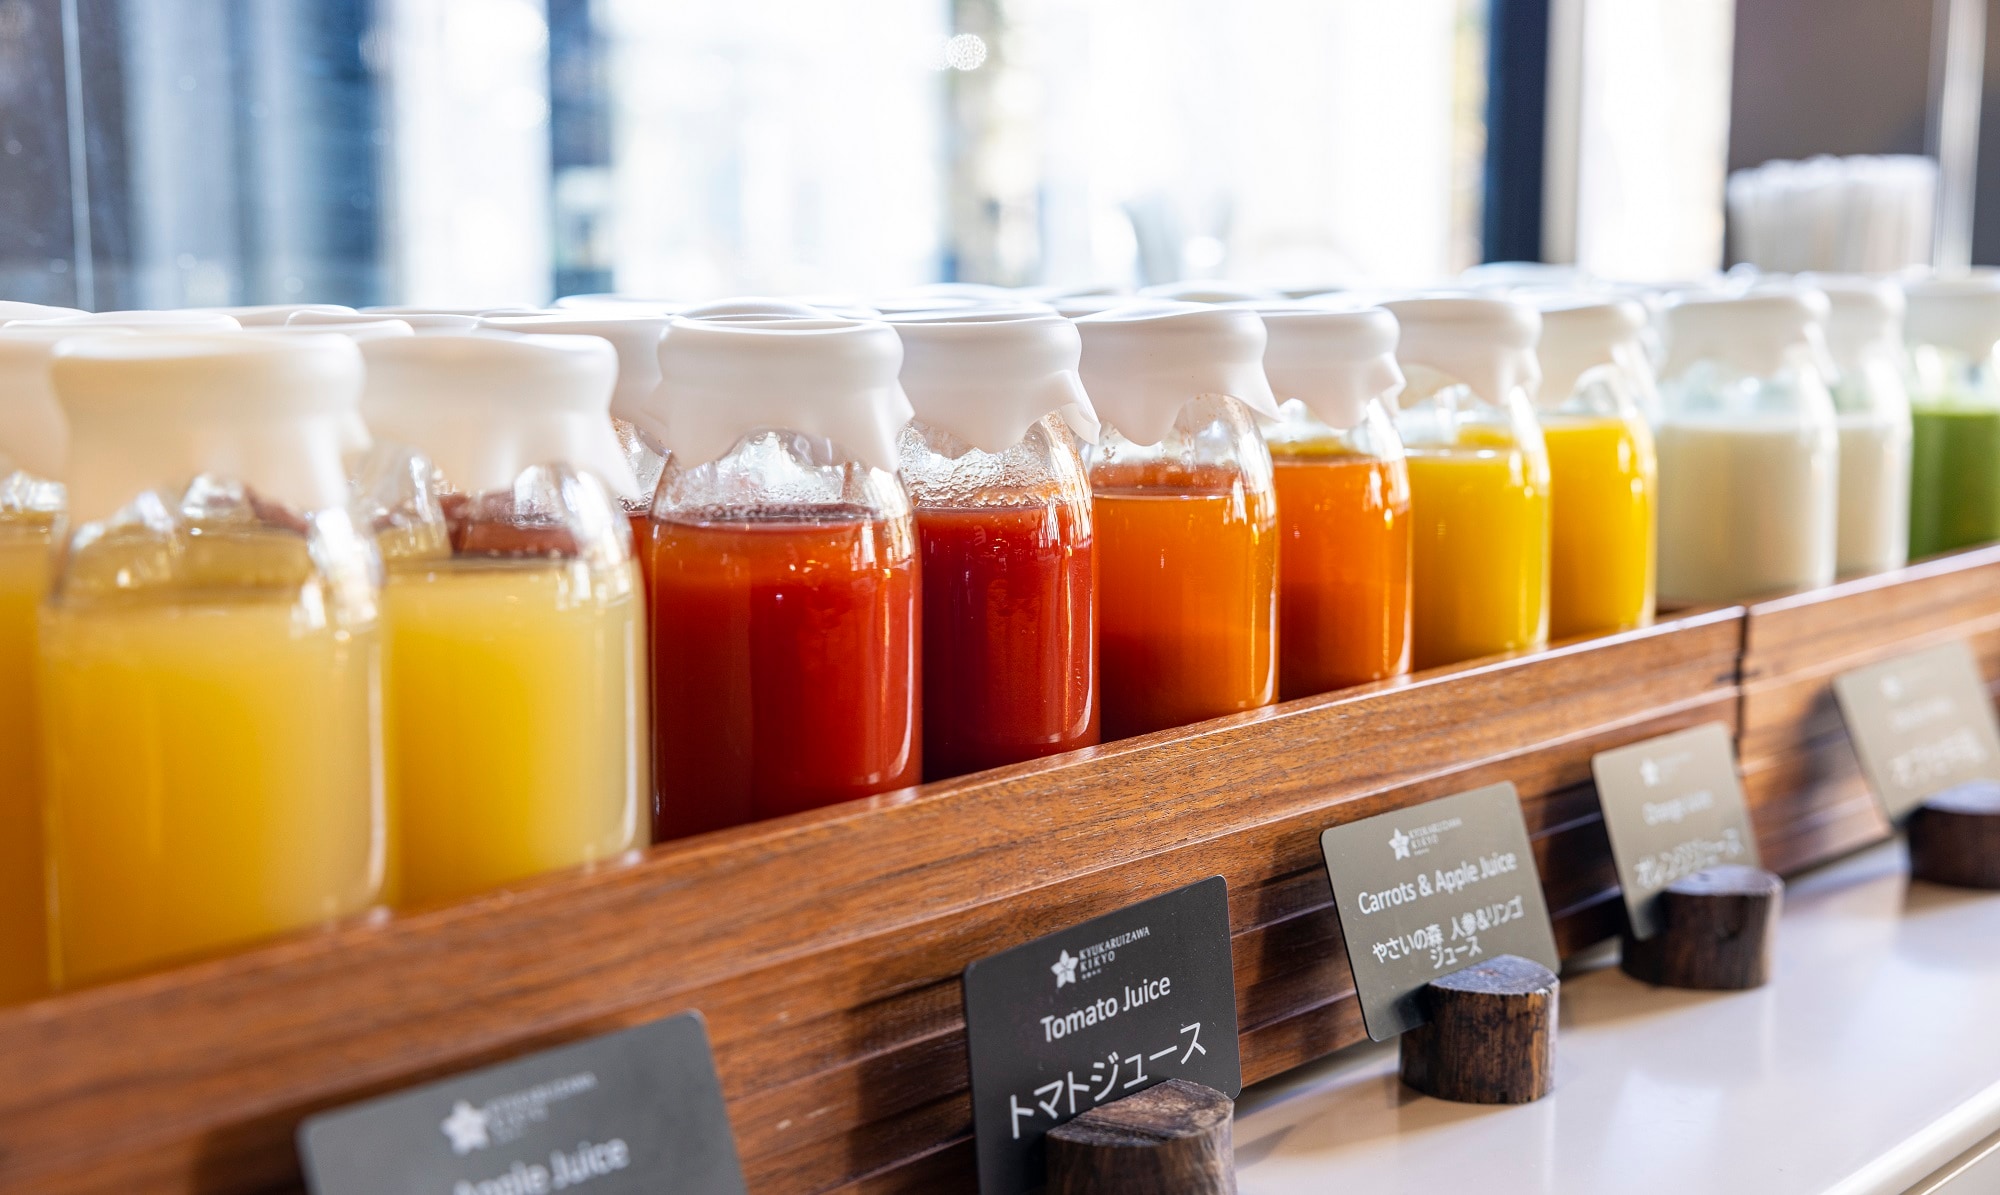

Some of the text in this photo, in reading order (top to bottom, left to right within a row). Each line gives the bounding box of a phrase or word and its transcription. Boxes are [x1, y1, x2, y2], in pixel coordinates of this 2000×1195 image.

[1358, 852, 1518, 915] Carrots & Apple Juice
[1079, 926, 1151, 960] KYUKARUIZAWA
[1080, 950, 1116, 973] KIKYO
[1372, 923, 1444, 964] やさいの森
[1430, 936, 1483, 970] ジュース
[1040, 976, 1171, 1043] Tomato Juice
[1009, 1022, 1207, 1140] トマトジュース
[550, 1138, 631, 1190] Juice
